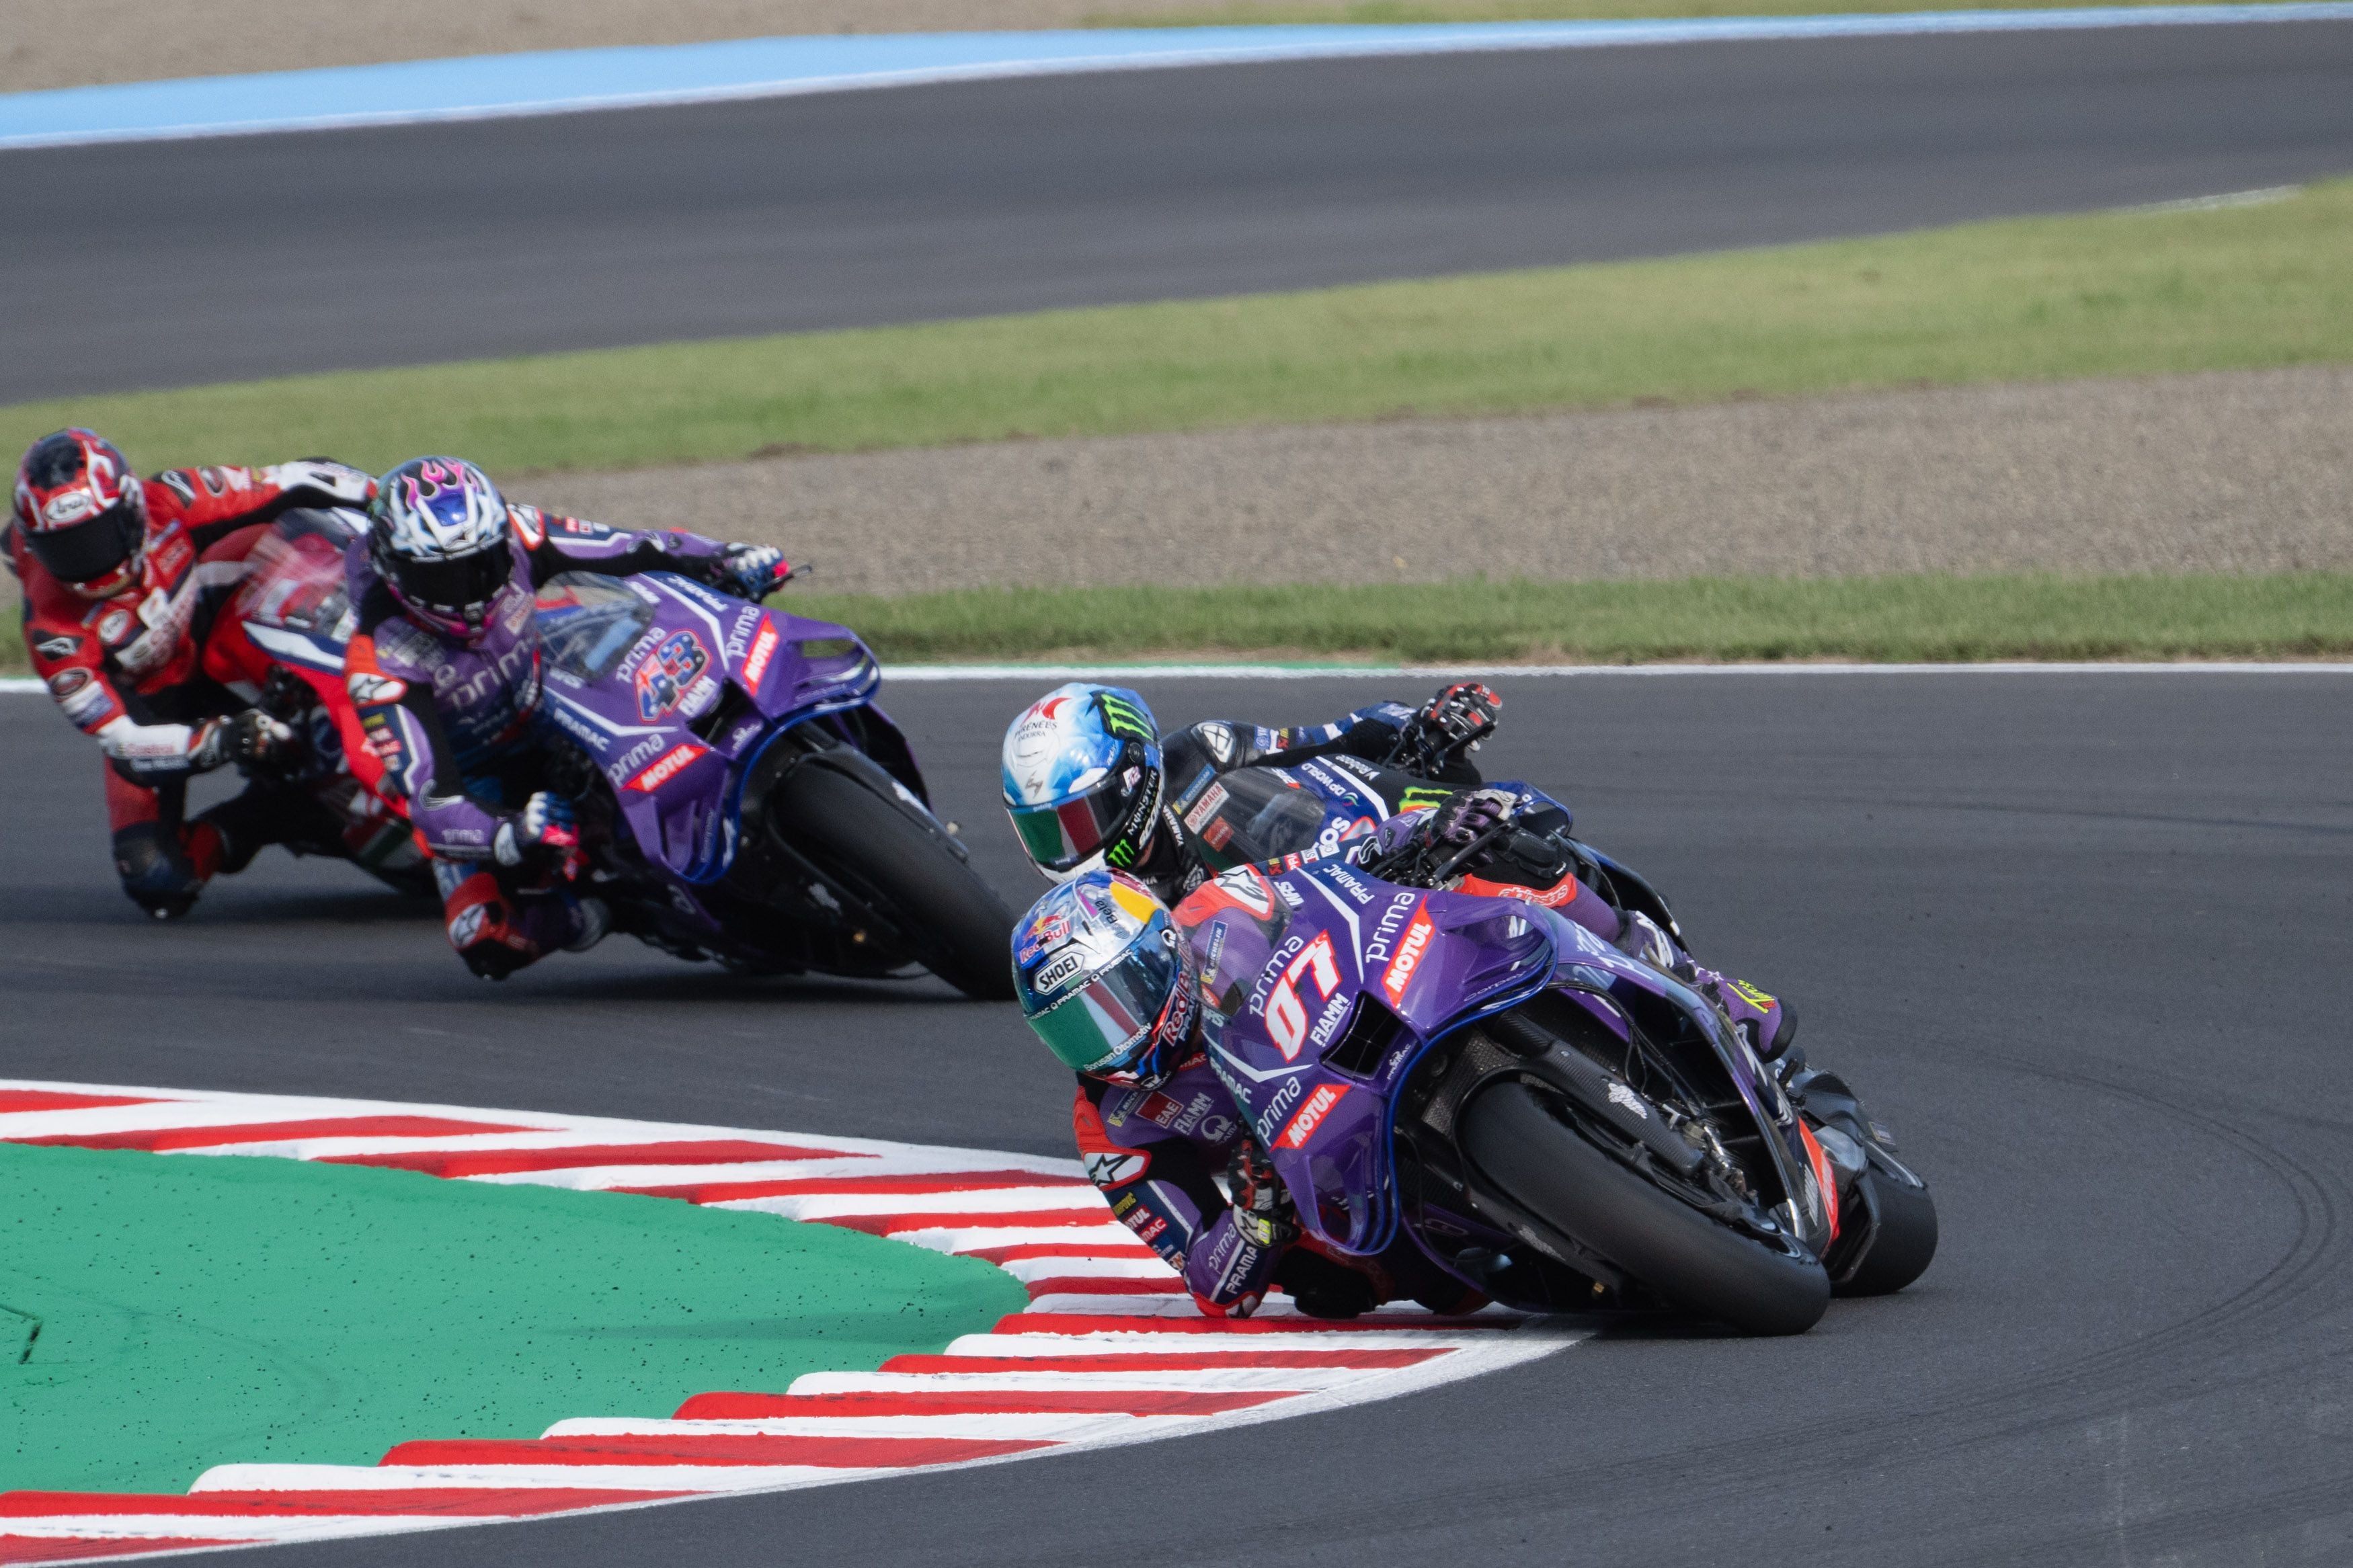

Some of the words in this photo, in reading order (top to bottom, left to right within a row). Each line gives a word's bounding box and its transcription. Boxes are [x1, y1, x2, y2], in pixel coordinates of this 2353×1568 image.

[615, 627, 666, 684] prima
[726, 606, 760, 658] prima
[744, 630, 777, 682] MOTUL
[449, 638, 531, 711] prim
[554, 707, 610, 752] PRAMAC
[606, 734, 665, 786] prima
[641, 745, 695, 790] MOTUL
[1301, 762, 1334, 787] WORLD
[1194, 784, 1224, 817] YAMAHA
[1328, 783, 1347, 796] DP
[1274, 881, 1304, 906] WRS
[1323, 864, 1375, 905] PRAMAC
[1043, 920, 1071, 943] Bull
[1095, 899, 1119, 924] Beta
[1365, 893, 1415, 963] prima
[1039, 956, 1078, 990] SHOEI
[1057, 979, 1092, 1006] PRAMAC
[1099, 948, 1133, 976] PRAMAC
[1250, 936, 1304, 1017] prima
[1386, 923, 1432, 992] MOTUL
[1162, 987, 1189, 1047] Red
[1264, 929, 1343, 1064] 07
[1310, 992, 1350, 1046] FIAMM
[1083, 1052, 1115, 1071] Borusan
[1113, 1023, 1152, 1055] Otomotiv
[1180, 1055, 1207, 1069] MAC
[1210, 1057, 1252, 1104] PRAMAC
[1154, 1102, 1179, 1124] EAE
[1173, 1091, 1212, 1134] FIAMM
[1258, 1076, 1302, 1147] prima
[1287, 1086, 1337, 1147] MOTUL
[1125, 1208, 1150, 1229] OTUL
[1141, 1219, 1166, 1241] MAC
[1209, 1223, 1237, 1274] prima
[1226, 1245, 1257, 1294] PRAMA
